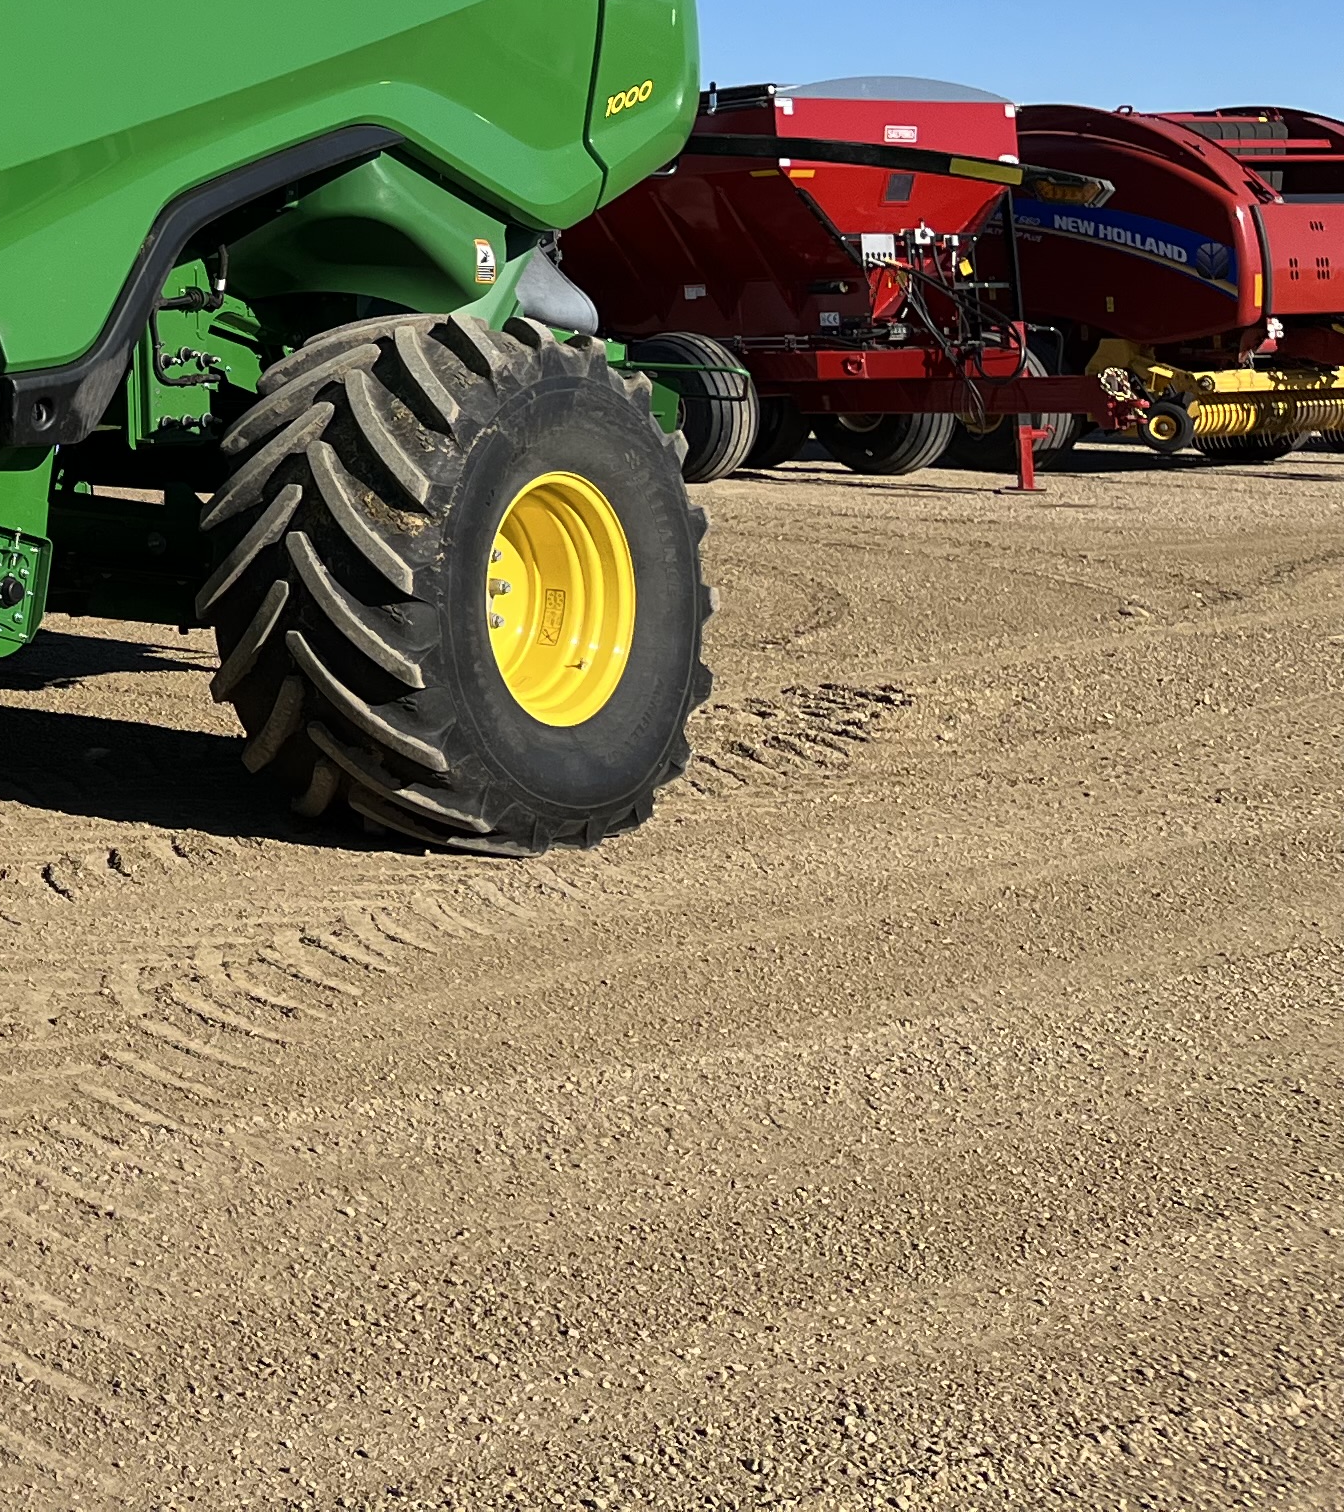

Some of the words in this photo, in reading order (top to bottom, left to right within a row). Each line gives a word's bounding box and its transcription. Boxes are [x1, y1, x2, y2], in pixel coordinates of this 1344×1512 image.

[605, 79, 654, 119] 1000
[1053, 213, 1097, 235] NEW
[1098, 222, 1188, 263] HOLLAND
